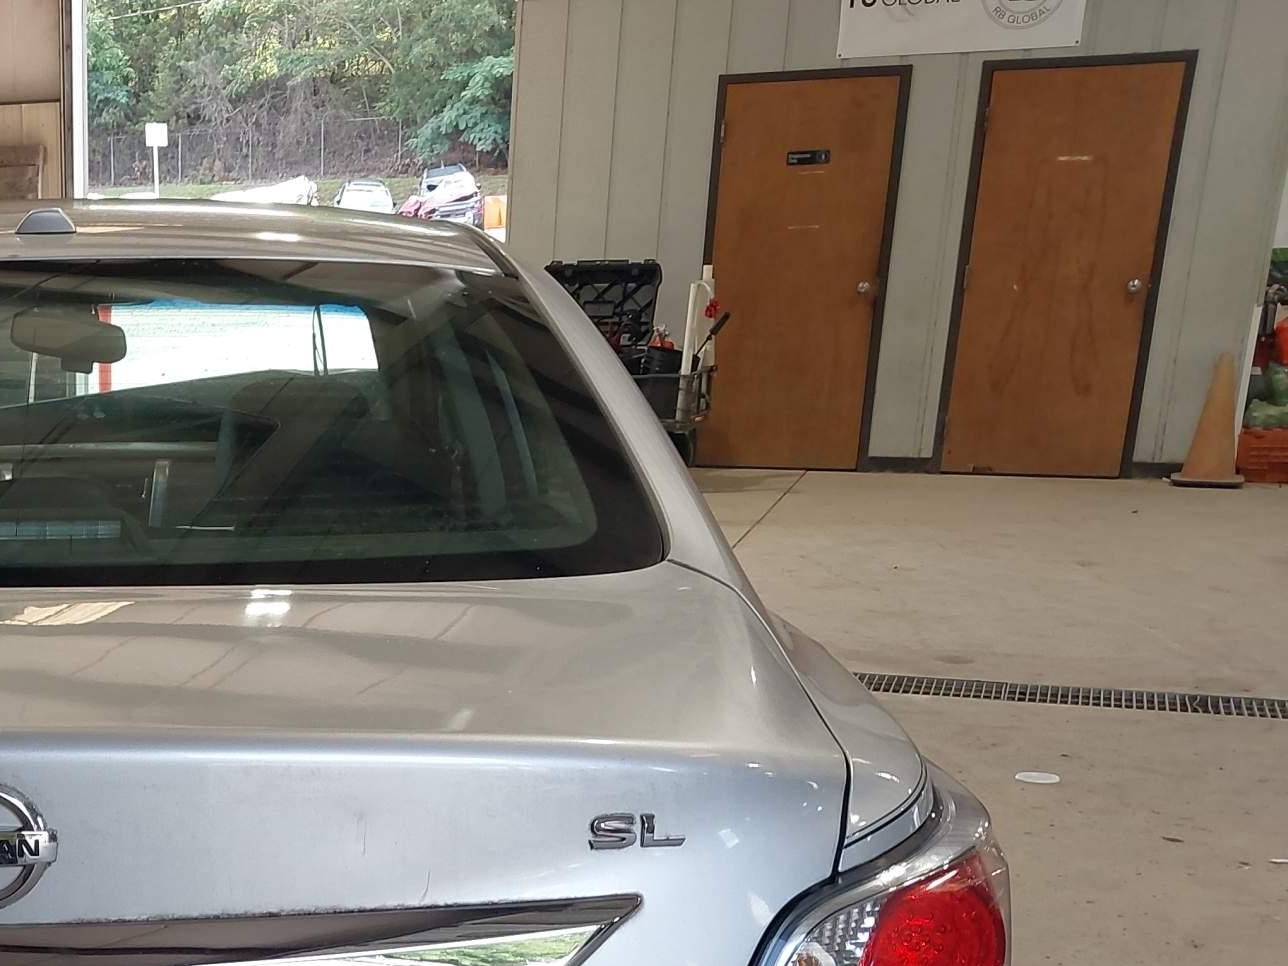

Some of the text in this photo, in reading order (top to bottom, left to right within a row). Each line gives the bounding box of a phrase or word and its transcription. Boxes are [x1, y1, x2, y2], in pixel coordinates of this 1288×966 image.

[992, 6, 1051, 24] RB GLOBAL
[588, 812, 686, 850] SL
